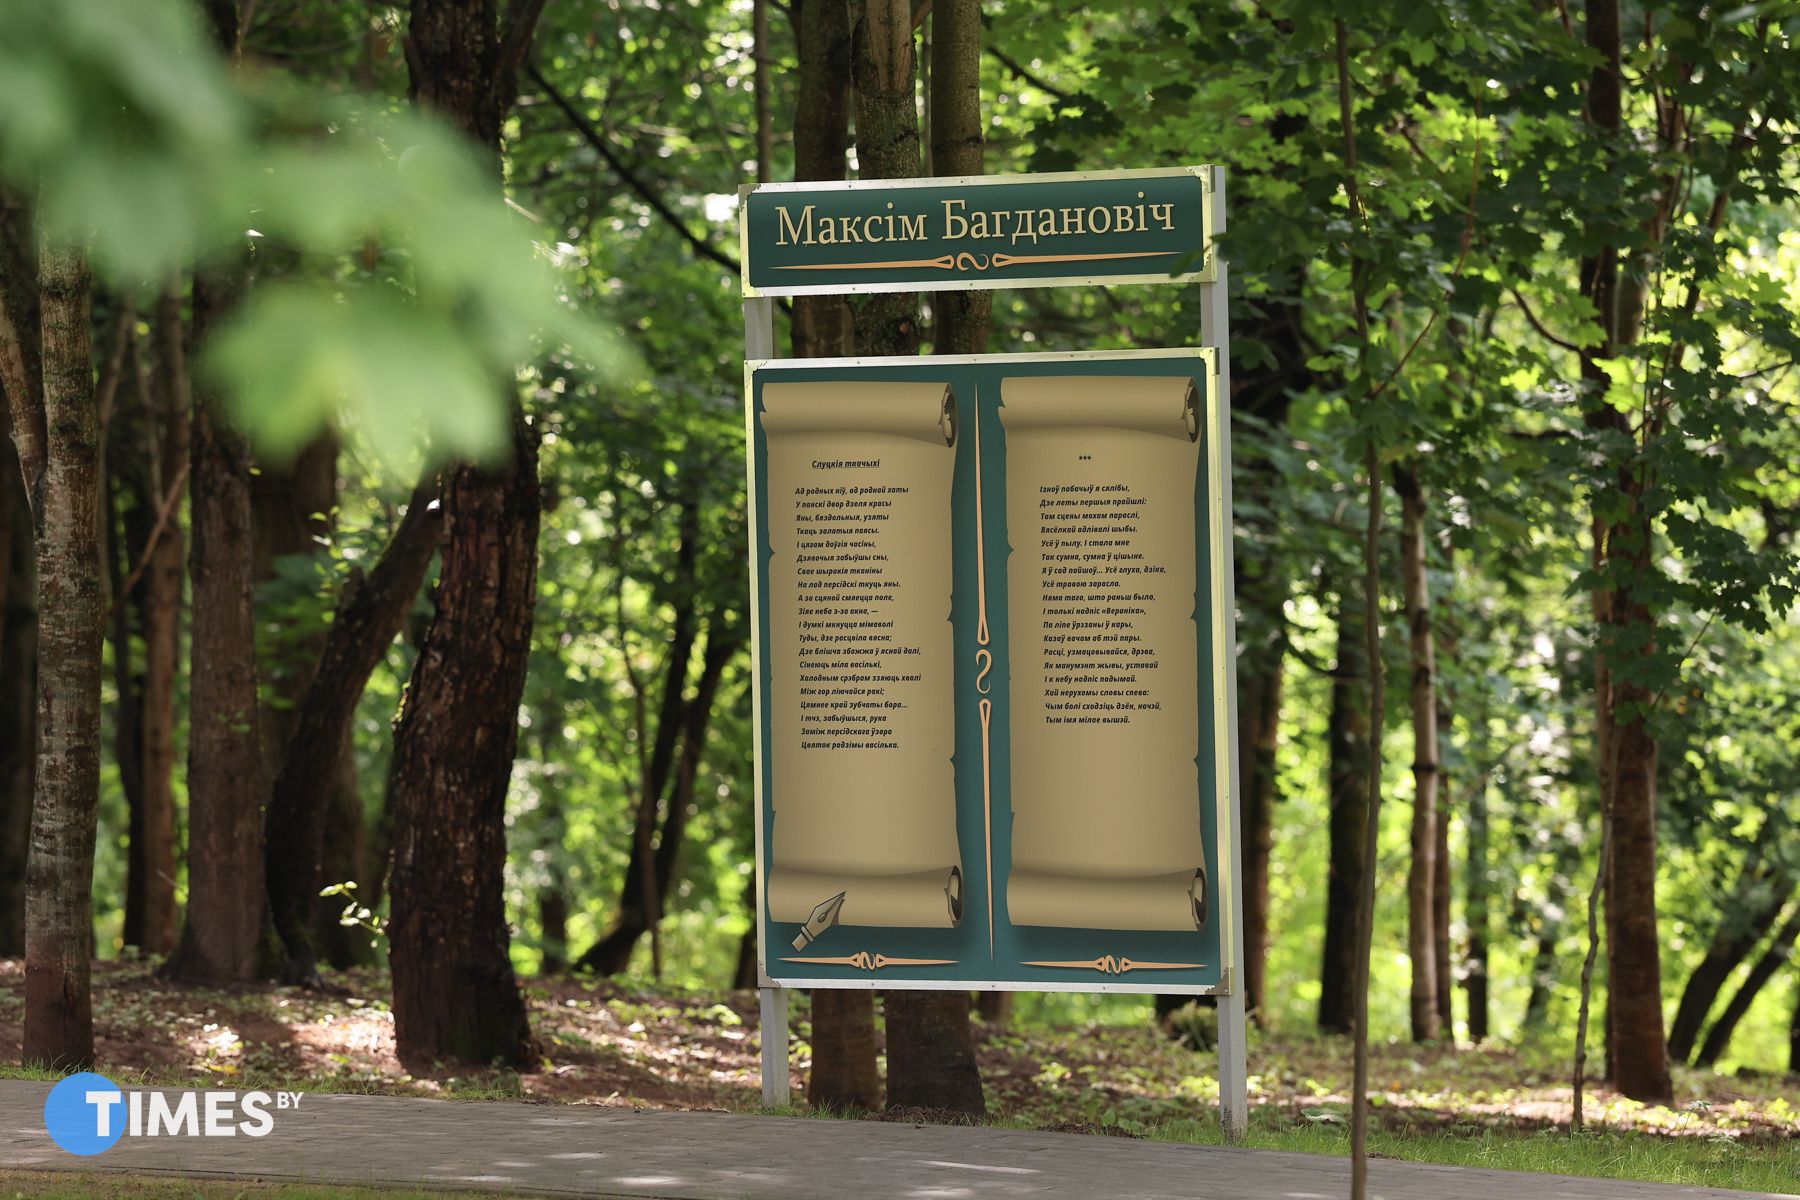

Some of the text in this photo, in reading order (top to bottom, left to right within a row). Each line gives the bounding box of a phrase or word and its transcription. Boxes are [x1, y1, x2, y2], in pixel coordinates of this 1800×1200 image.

[775, 191, 1176, 246] Максім Багдановіч
[812, 459, 880, 470] Слуцкія ткачыхі
[806, 487, 834, 497] родных
[849, 486, 859, 494] ад
[859, 486, 886, 496] роднай
[1040, 484, 1130, 495] Ізноў пабачыў сялібы,
[802, 500, 892, 509] панскі двор дзеля красы
[1040, 499, 1055, 508] Дзе
[1080, 500, 1111, 508] першыя
[815, 514, 862, 522] бяздольныя,
[863, 515, 889, 523] узяты
[1109, 511, 1140, 521] параслі,
[797, 528, 818, 536] Ткаць
[1041, 525, 1138, 534] Вясёлкай адлівалі шыбы.
[825, 540, 848, 550] доўгія
[849, 540, 876, 548] часіны,
[1061, 541, 1082, 549] пылу.
[796, 555, 835, 563] Дзявочыя
[836, 553, 871, 563] забыўшы
[1056, 555, 1081, 563] сумна,
[1083, 554, 1106, 562] сумна
[1113, 552, 1144, 562] цішыне.
[816, 567, 849, 577] шырокія
[1054, 566, 1067, 574] сад
[1105, 566, 1118, 574] Усё
[1144, 565, 1166, 574] дзіка,
[823, 580, 857, 590] персідскі
[858, 582, 882, 590] ткуць
[1042, 580, 1121, 590] Усё травою зарасло.
[814, 594, 840, 603] сцяной
[841, 595, 874, 603] смяецца
[1107, 595, 1132, 603] раньш
[1133, 593, 1156, 601] было,
[815, 607, 832, 615] неба
[1047, 607, 1075, 615] толькі
[1076, 607, 1100, 615] надпіс
[803, 620, 894, 630] думкі мкнуцца мімаволі
[1043, 621, 1133, 630] Па ліпе ўрэзаны кары,
[800, 634, 819, 643] Туды,
[821, 634, 834, 642] дзе
[834, 634, 867, 644] расцвіла
[1044, 634, 1066, 644] Казаў
[1092, 634, 1102, 642] аб
[1103, 634, 1119, 642] тэй
[1119, 635, 1142, 644] пары.
[799, 648, 814, 657] Дзе
[842, 647, 874, 655] збожжа
[880, 647, 902, 655] яснай
[903, 647, 921, 655] далі,
[1044, 648, 1066, 657] Расці,
[1131, 648, 1155, 657] дрэва,
[800, 661, 830, 670] Сінеюць
[850, 660, 882, 669] васількі,
[1125, 661, 1159, 671] уставай
[800, 674, 839, 682] Халодным
[840, 674, 871, 684] срэбрам
[901, 674, 922, 682] хвалі
[1055, 675, 1137, 685] небу надпіс падымай.
[818, 689, 830, 697] гор
[831, 687, 866, 695] ліючайся
[1060, 690, 1099, 698] нерухомы
[830, 701, 848, 710] край
[849, 701, 883, 710] зубчаты
[1045, 702, 1063, 710] Чым
[1065, 702, 1081, 710] болі
[1082, 702, 1115, 711] сходзіць
[1116, 702, 1136, 711] дзён,
[823, 714, 868, 724] забыўшыся,
[869, 716, 887, 724] рука
[1063, 716, 1077, 724] імя
[1078, 716, 1101, 724] мілае
[1102, 716, 1130, 724] вышэй.
[826, 728, 870, 737] персідскага
[870, 727, 892, 737] ўзора
[802, 741, 899, 750] Цвяток радзімы васілька.
